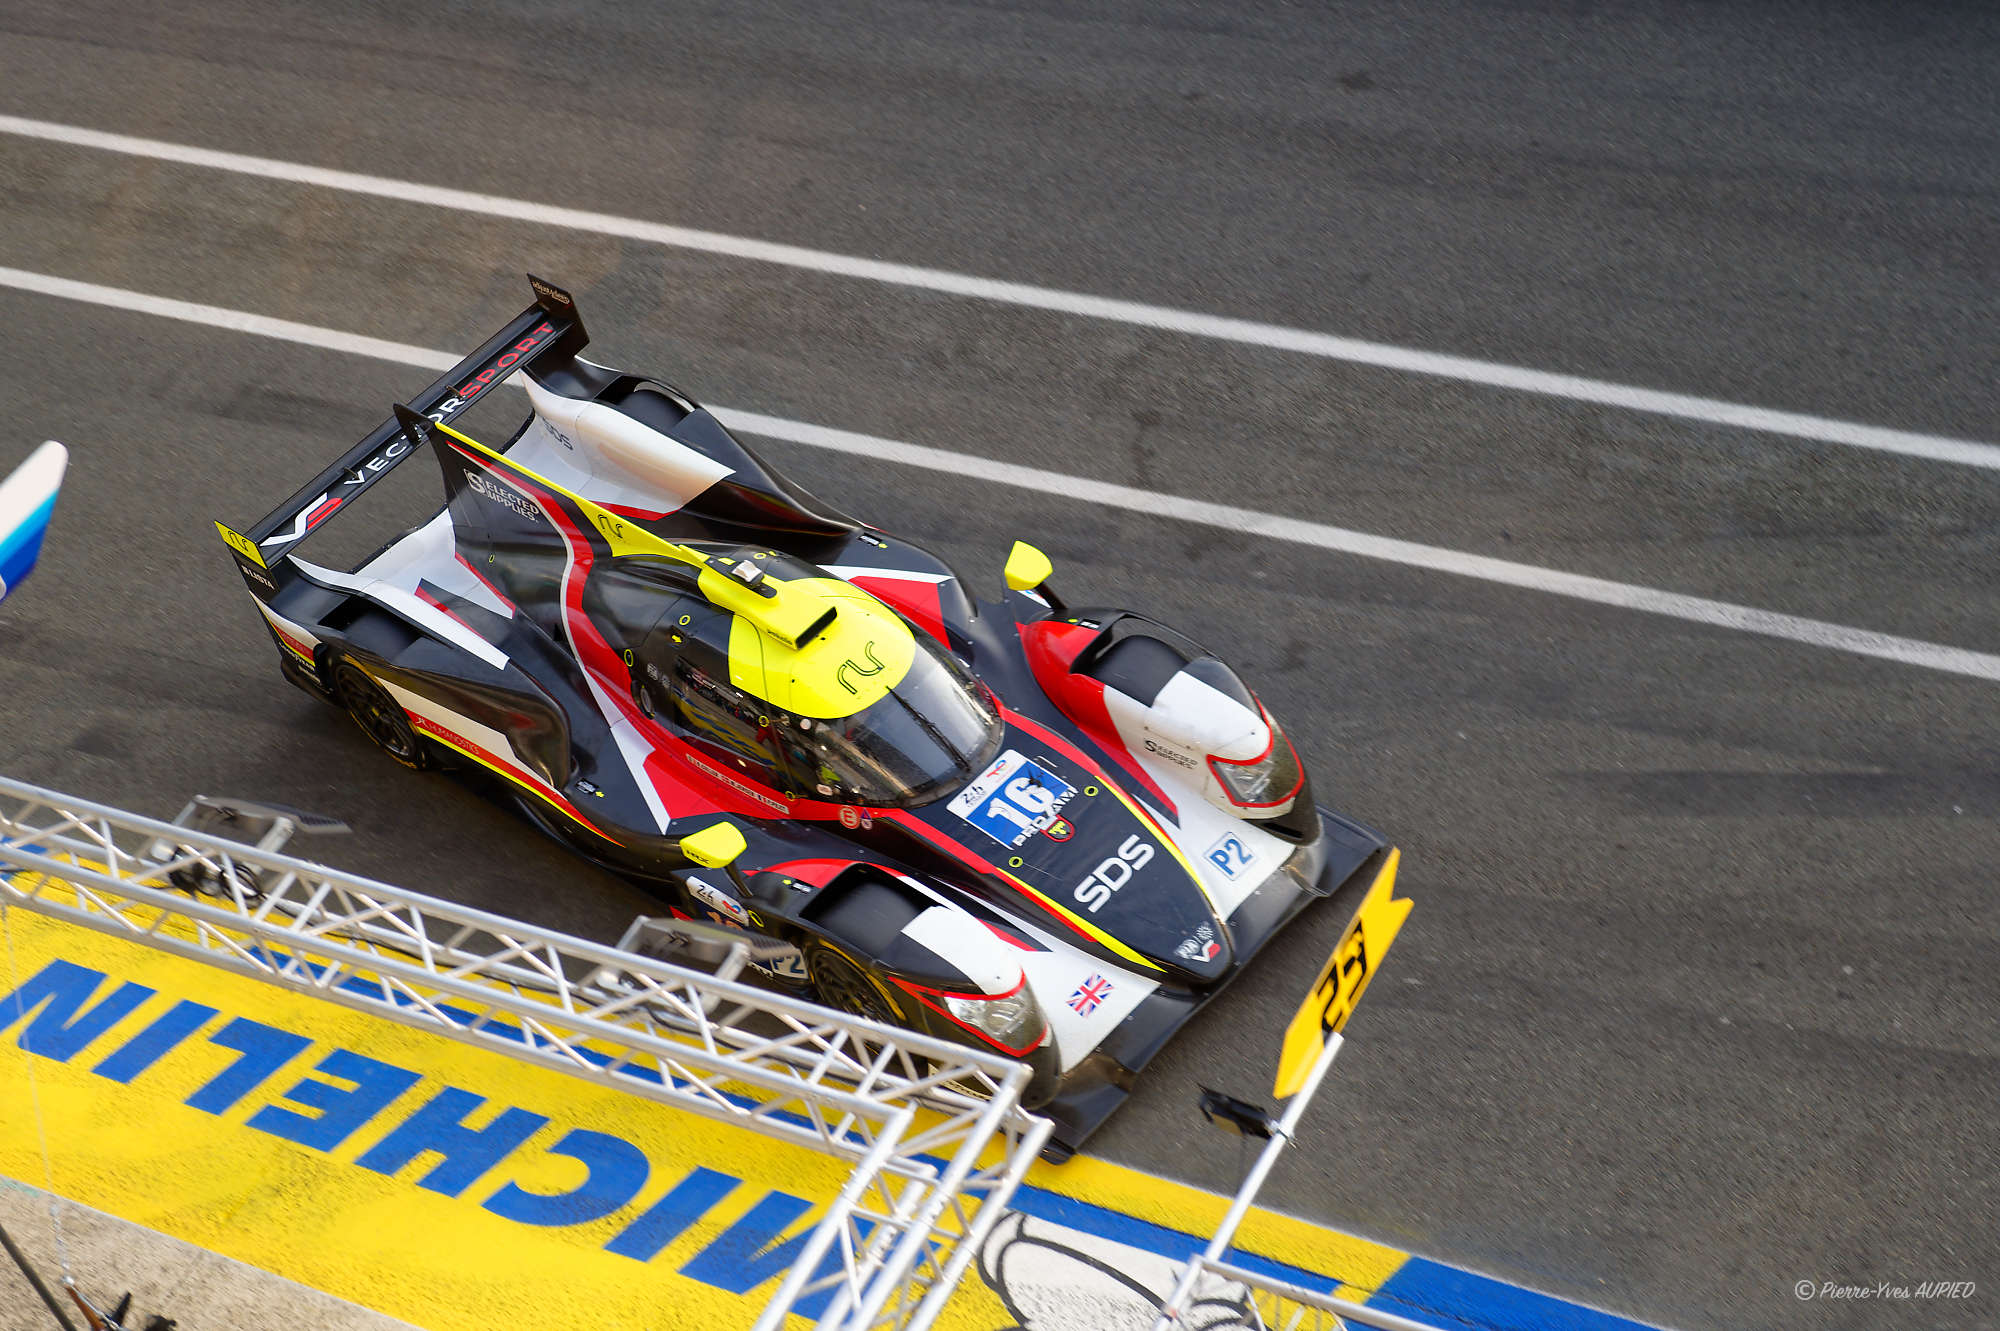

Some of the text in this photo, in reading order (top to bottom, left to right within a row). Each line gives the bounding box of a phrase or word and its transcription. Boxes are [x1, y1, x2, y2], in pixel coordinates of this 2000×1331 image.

[986, 777, 1056, 830] 16
[1074, 834, 1155, 913] SDS
[1210, 838, 1252, 876] P2
